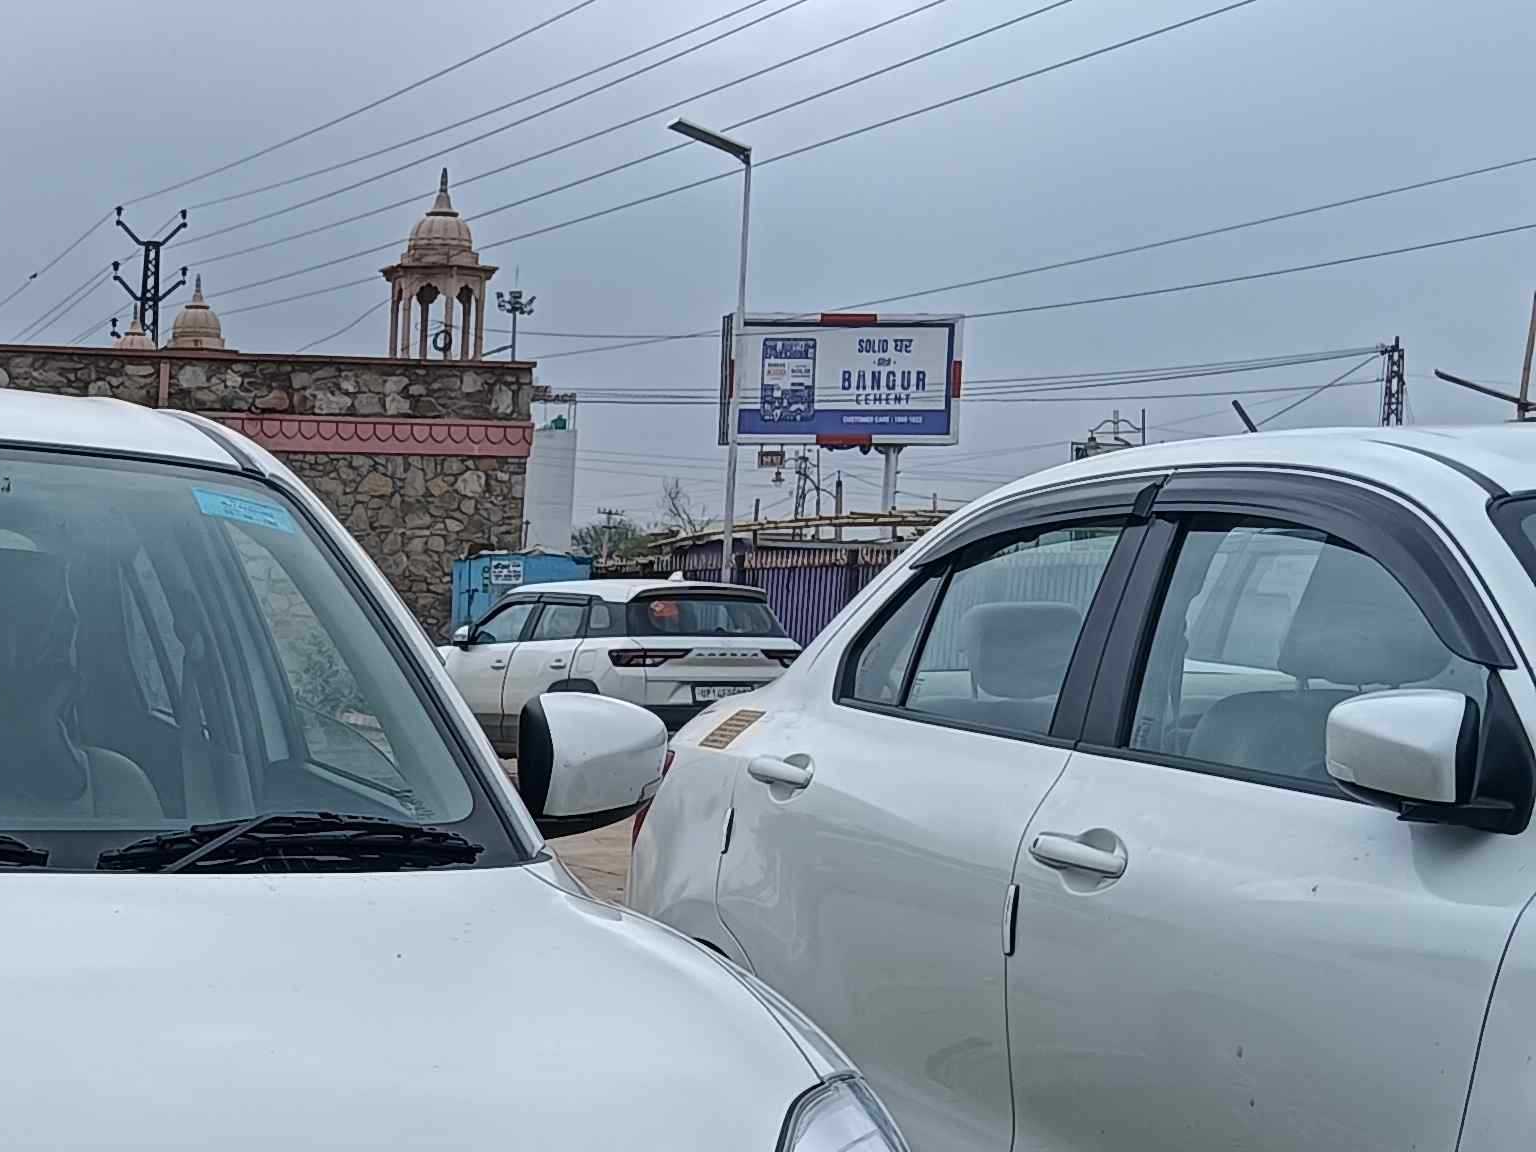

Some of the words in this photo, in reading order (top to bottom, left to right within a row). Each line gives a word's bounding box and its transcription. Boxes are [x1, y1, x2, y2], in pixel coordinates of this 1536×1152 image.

[857, 338, 889, 354] SOLID
[893, 338, 914, 354] घर
[841, 370, 926, 391] BANGUR
[855, 393, 911, 405] CEMENT
